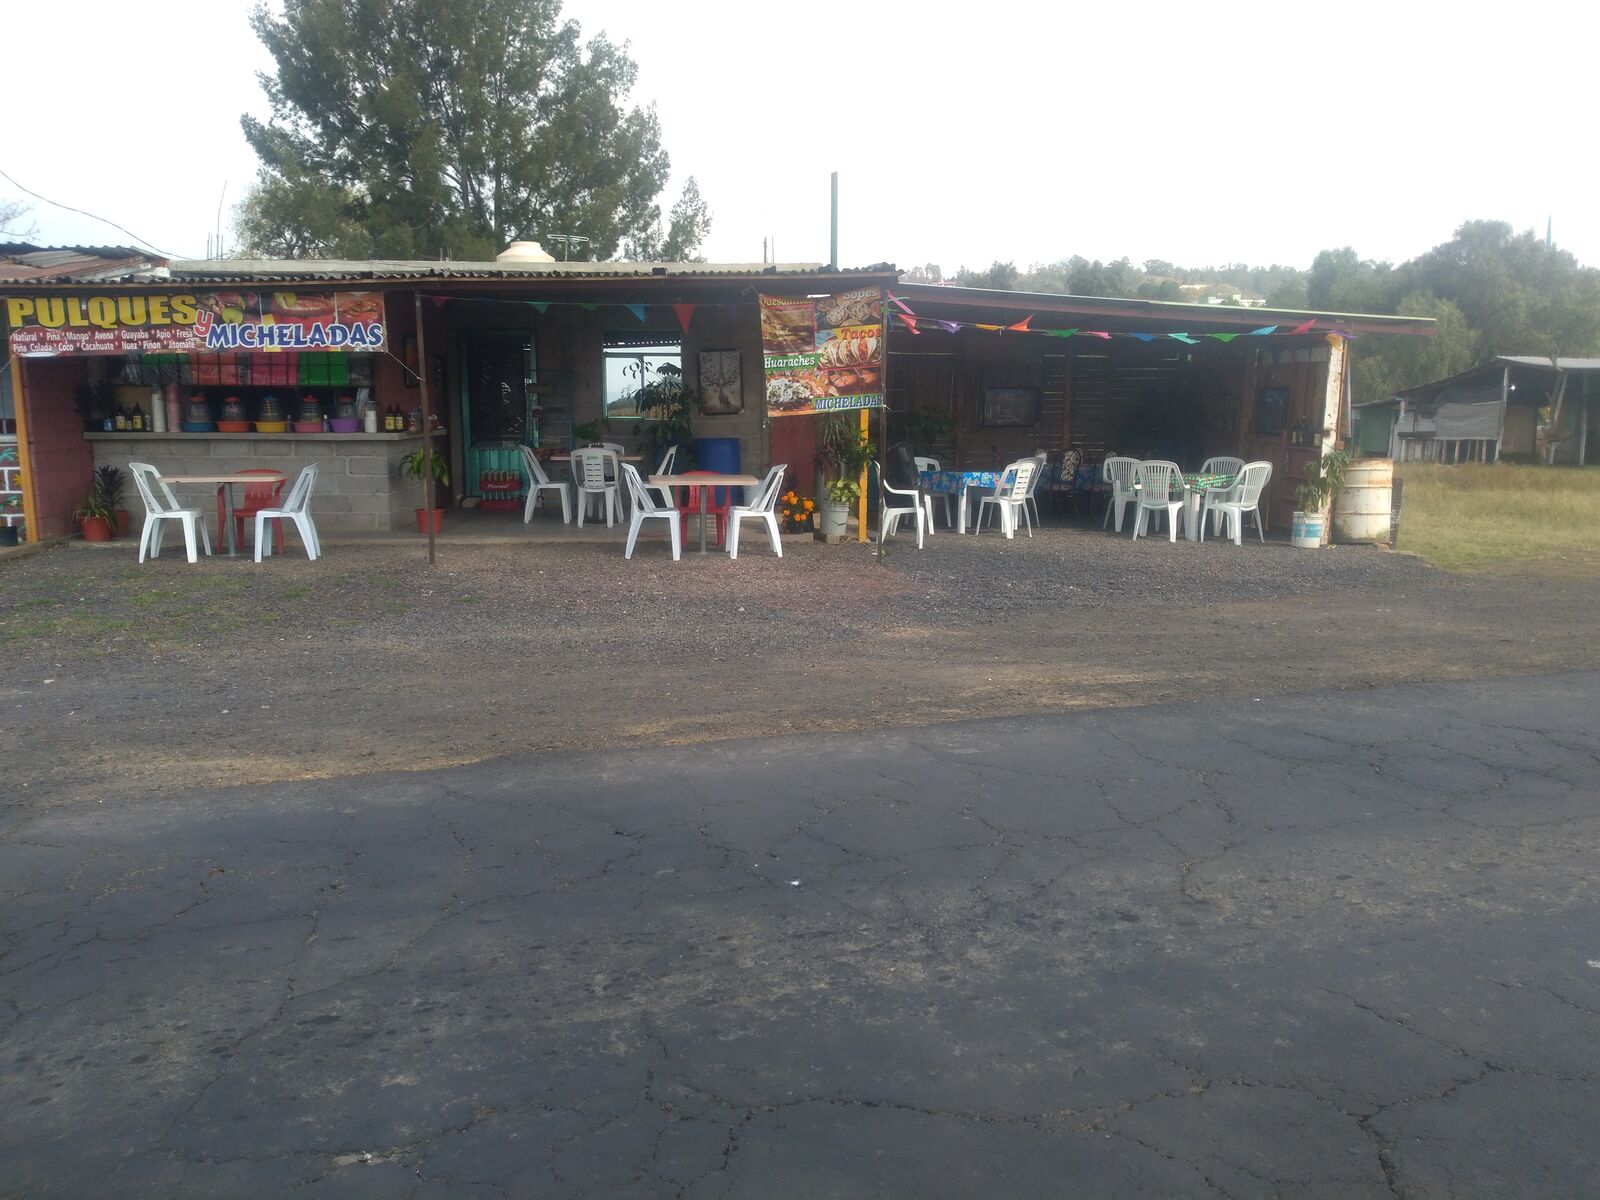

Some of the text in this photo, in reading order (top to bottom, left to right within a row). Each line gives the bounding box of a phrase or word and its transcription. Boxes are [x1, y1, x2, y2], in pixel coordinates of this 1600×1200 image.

[843, 288, 878, 300] Sopes
[6, 295, 197, 329] PULQUES
[13, 329, 193, 342] Natural Piña Mango Avena Guayaba Apio Fresa
[206, 322, 384, 348] MICHELADAS
[841, 328, 881, 339] Tacos
[13, 343, 27, 352] Piña
[30, 343, 53, 352] Colada
[58, 342, 74, 351] Coco
[81, 341, 115, 351] Cacahuate
[121, 341, 138, 350] Nuez
[168, 340, 195, 349] Jitomate
[764, 355, 815, 369] Huaraches
